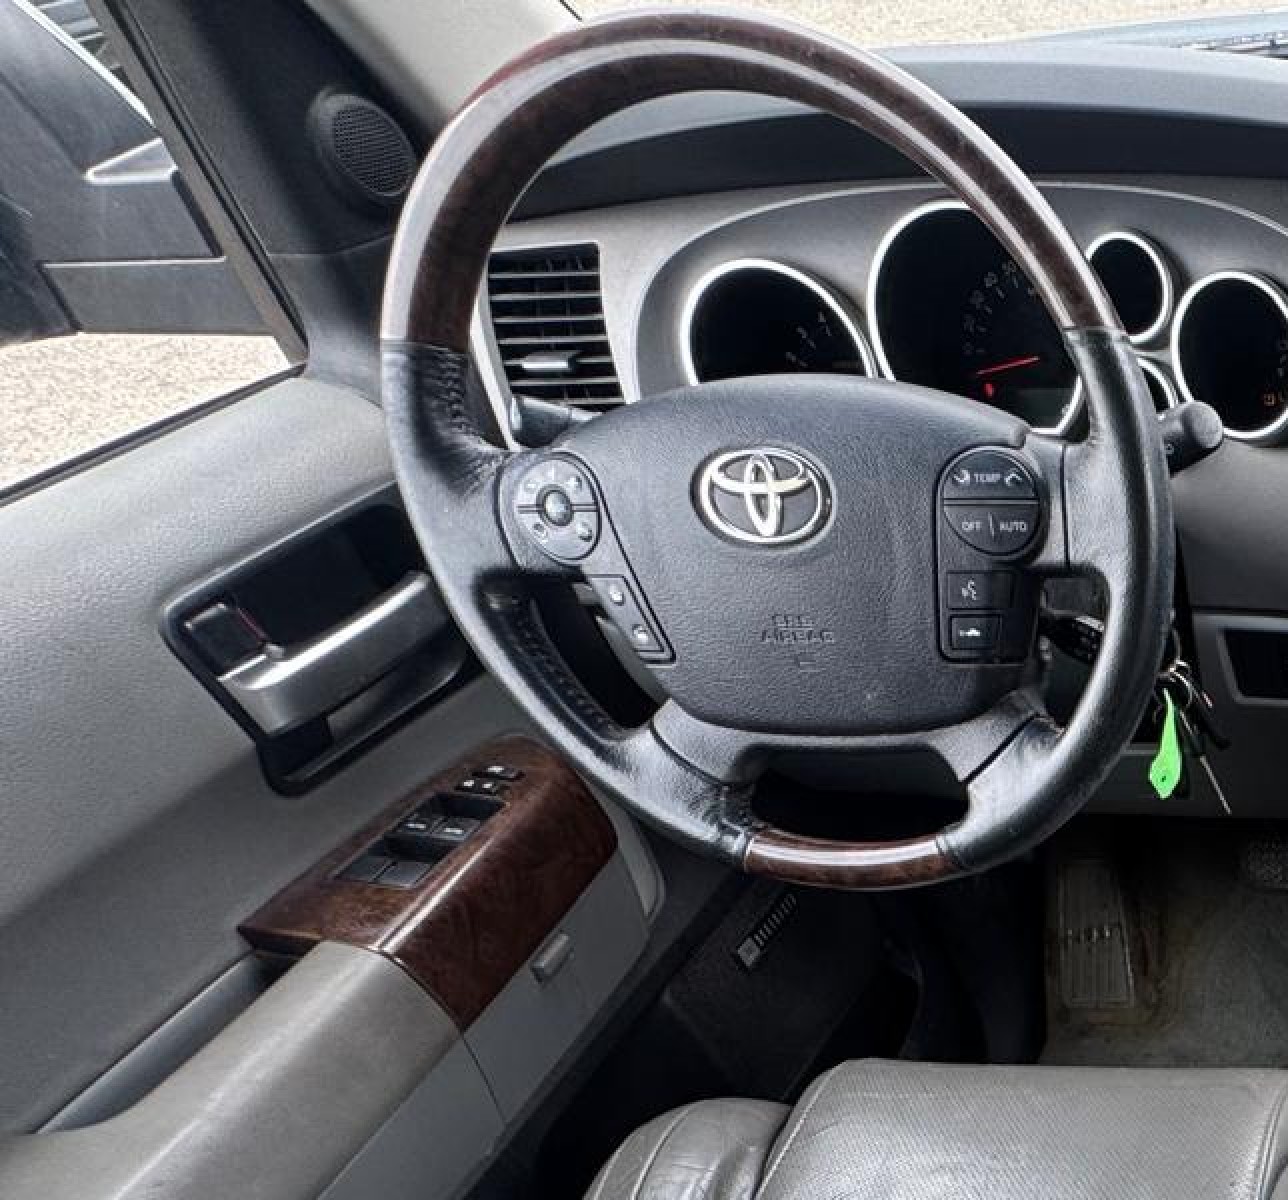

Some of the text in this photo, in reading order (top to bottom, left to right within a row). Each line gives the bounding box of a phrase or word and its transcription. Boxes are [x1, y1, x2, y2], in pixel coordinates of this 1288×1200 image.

[973, 473, 1001, 483] TEMP
[961, 521, 981, 532] OFF
[1000, 521, 1028, 532] AUTO
